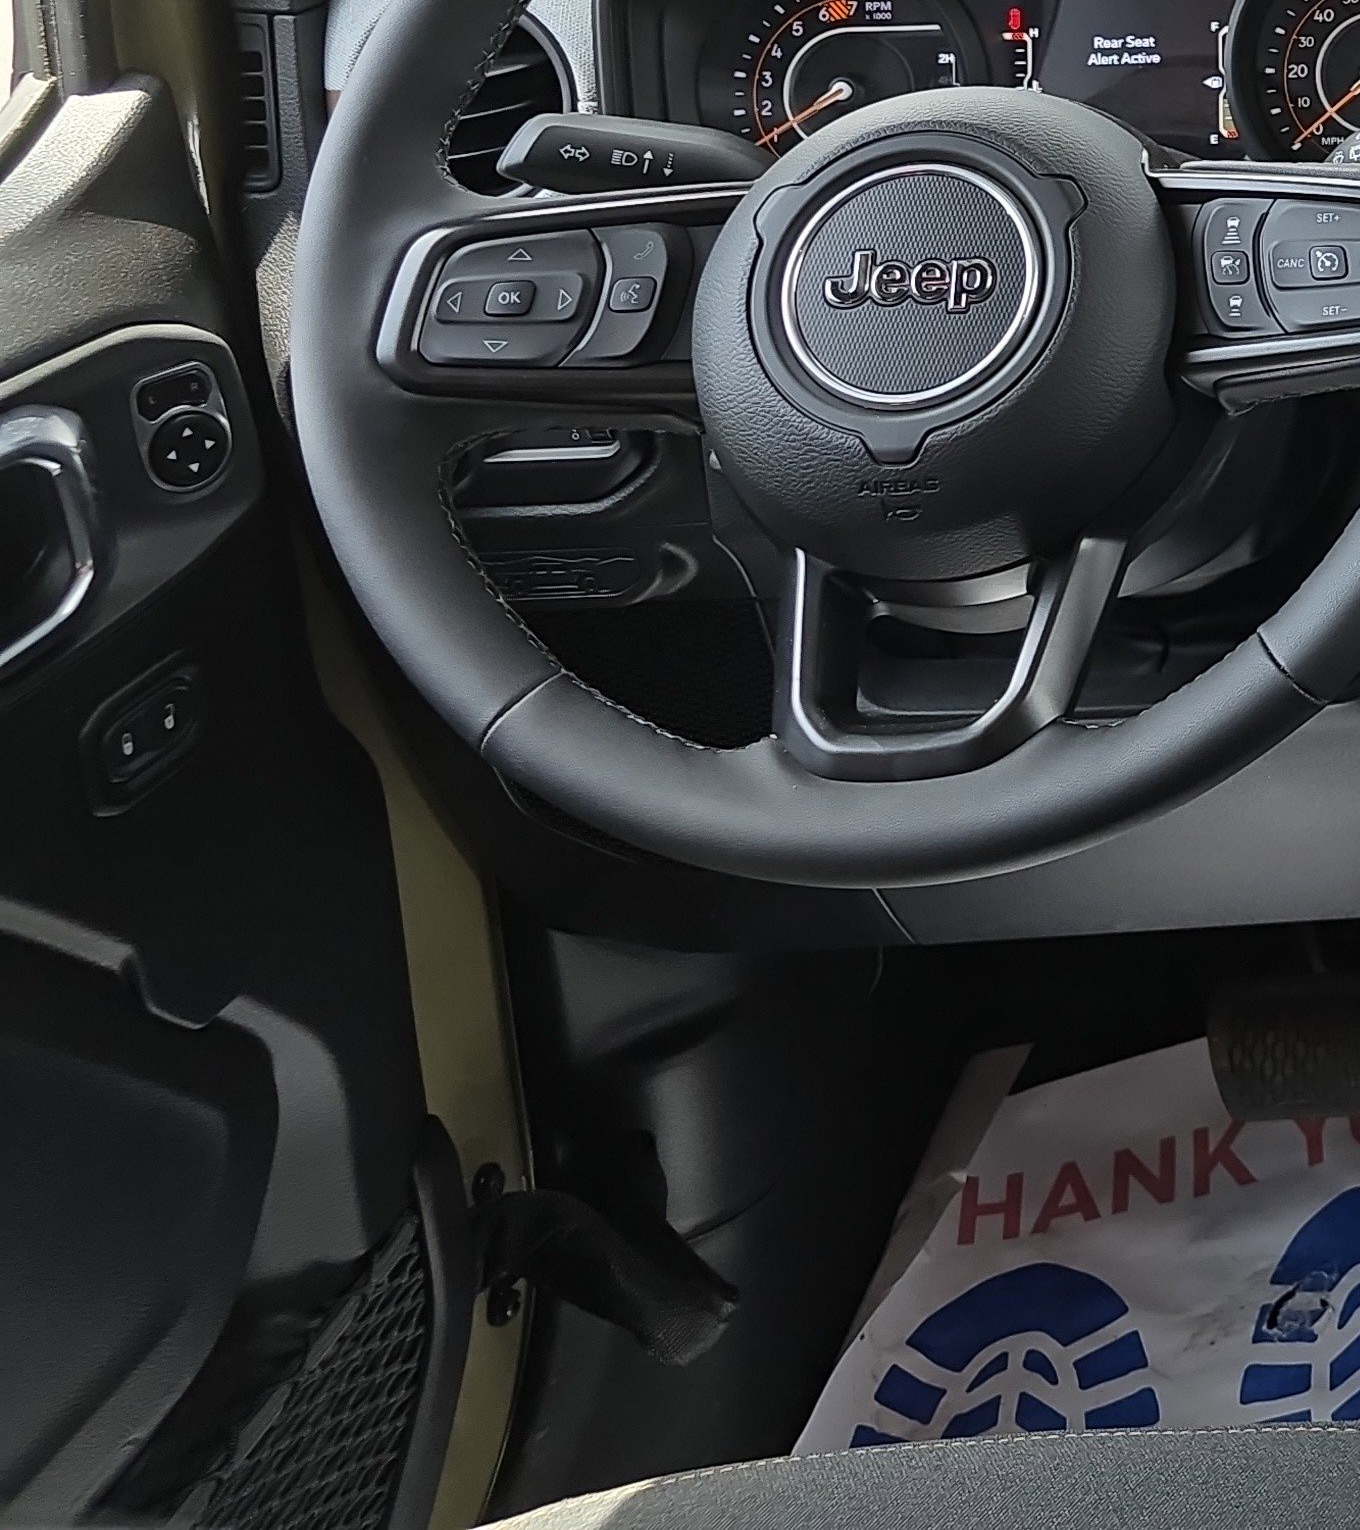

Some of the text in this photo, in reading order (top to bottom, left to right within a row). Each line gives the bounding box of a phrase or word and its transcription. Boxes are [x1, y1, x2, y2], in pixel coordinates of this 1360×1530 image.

[848, 1, 858, 16] 7
[865, 1, 892, 11] RPM
[819, 7, 830, 21] 6
[873, 12, 892, 20] 1000
[1314, 9, 1335, 22] 40
[792, 22, 803, 36] 5
[1093, 36, 1155, 49] Rear Seat
[1299, 36, 1315, 47] 30
[771, 44, 783, 59] 4
[1087, 53, 1161, 66] Alert Active
[1288, 64, 1308, 78] 20
[762, 71, 773, 87] 3
[761, 101, 772, 116] 2
[1298, 97, 1310, 107] 10
[1321, 137, 1344, 145] MPH
[1316, 213, 1341, 223] SET+
[1277, 258, 1305, 268] CANC
[824, 249, 997, 314] Jeep
[498, 292, 521, 304] OK
